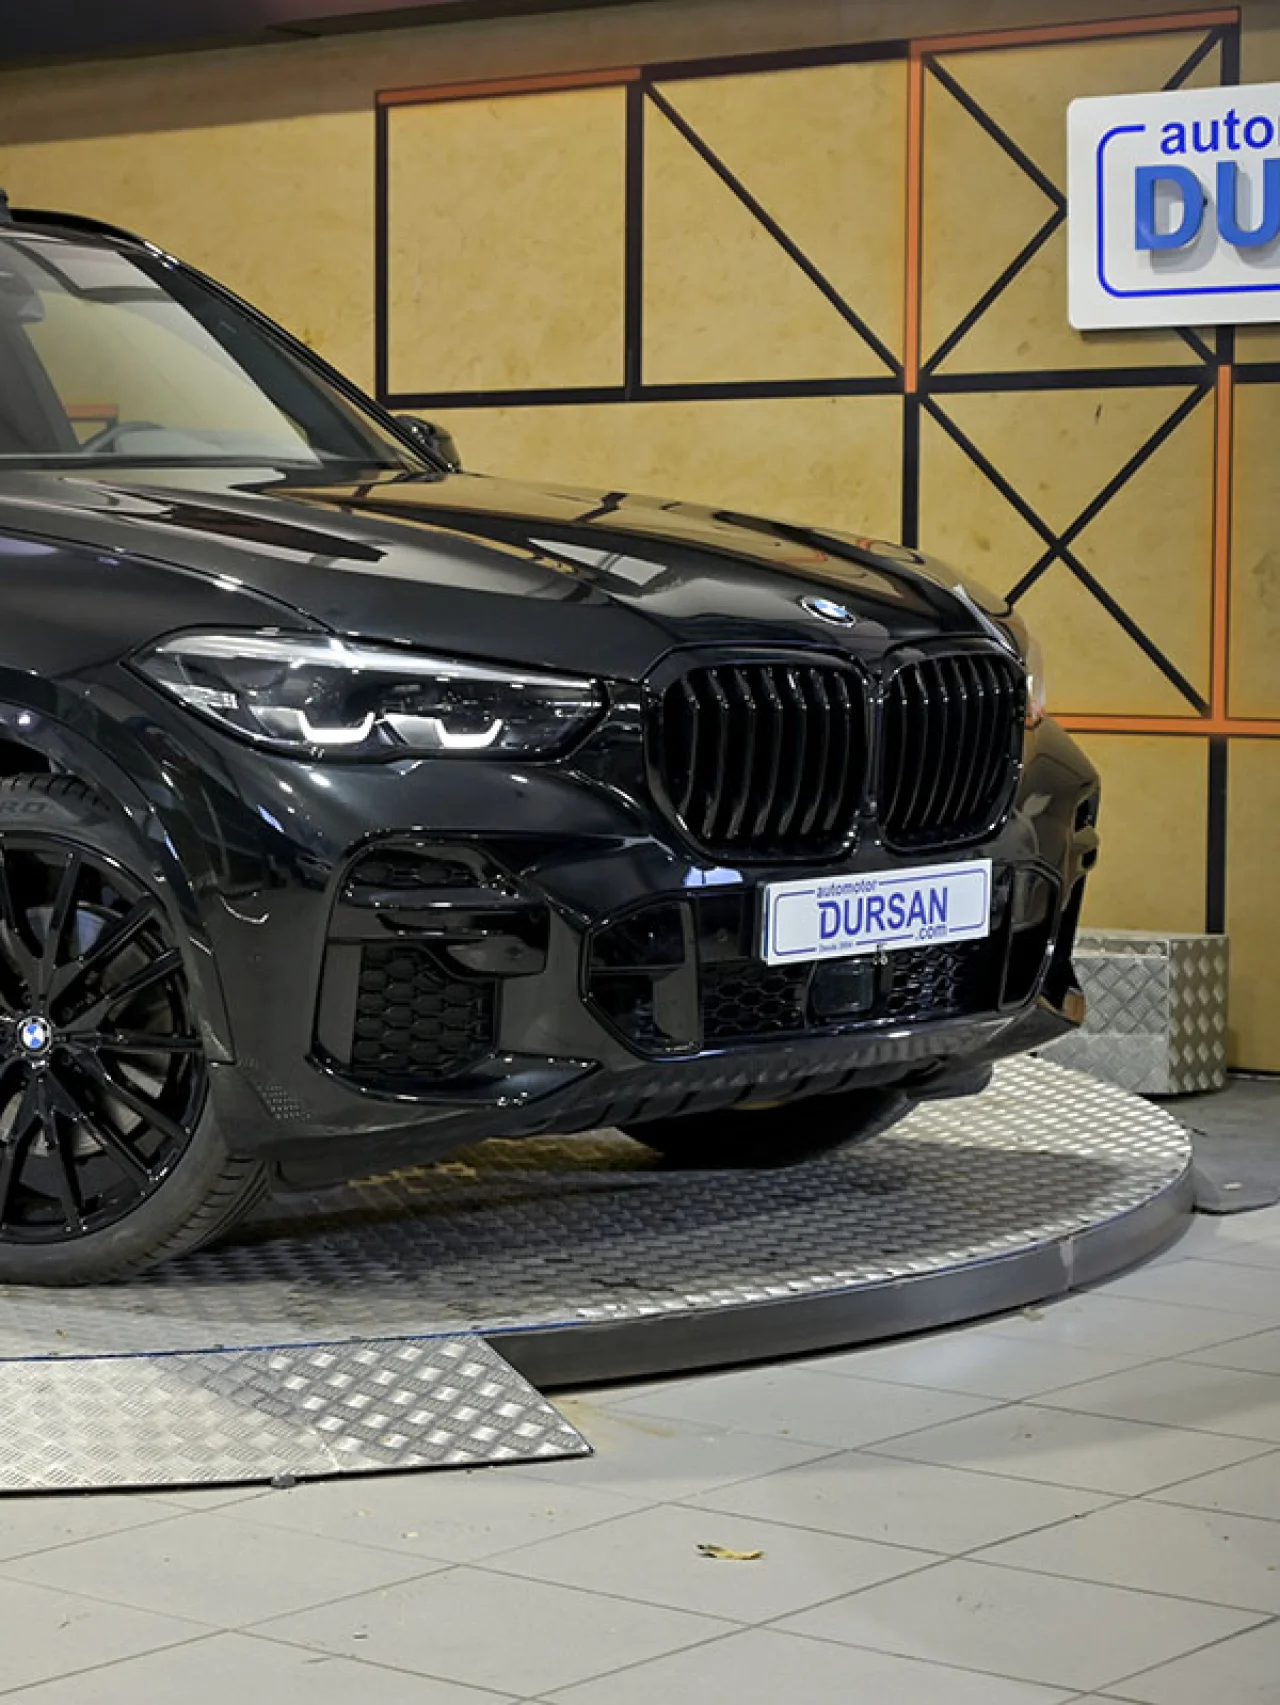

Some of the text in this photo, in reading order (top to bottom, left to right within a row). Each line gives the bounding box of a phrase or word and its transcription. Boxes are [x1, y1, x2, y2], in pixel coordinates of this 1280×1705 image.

[1160, 108, 1280, 155] auto
[816, 879, 878, 898] automotor
[817, 886, 948, 939] DURSAN
